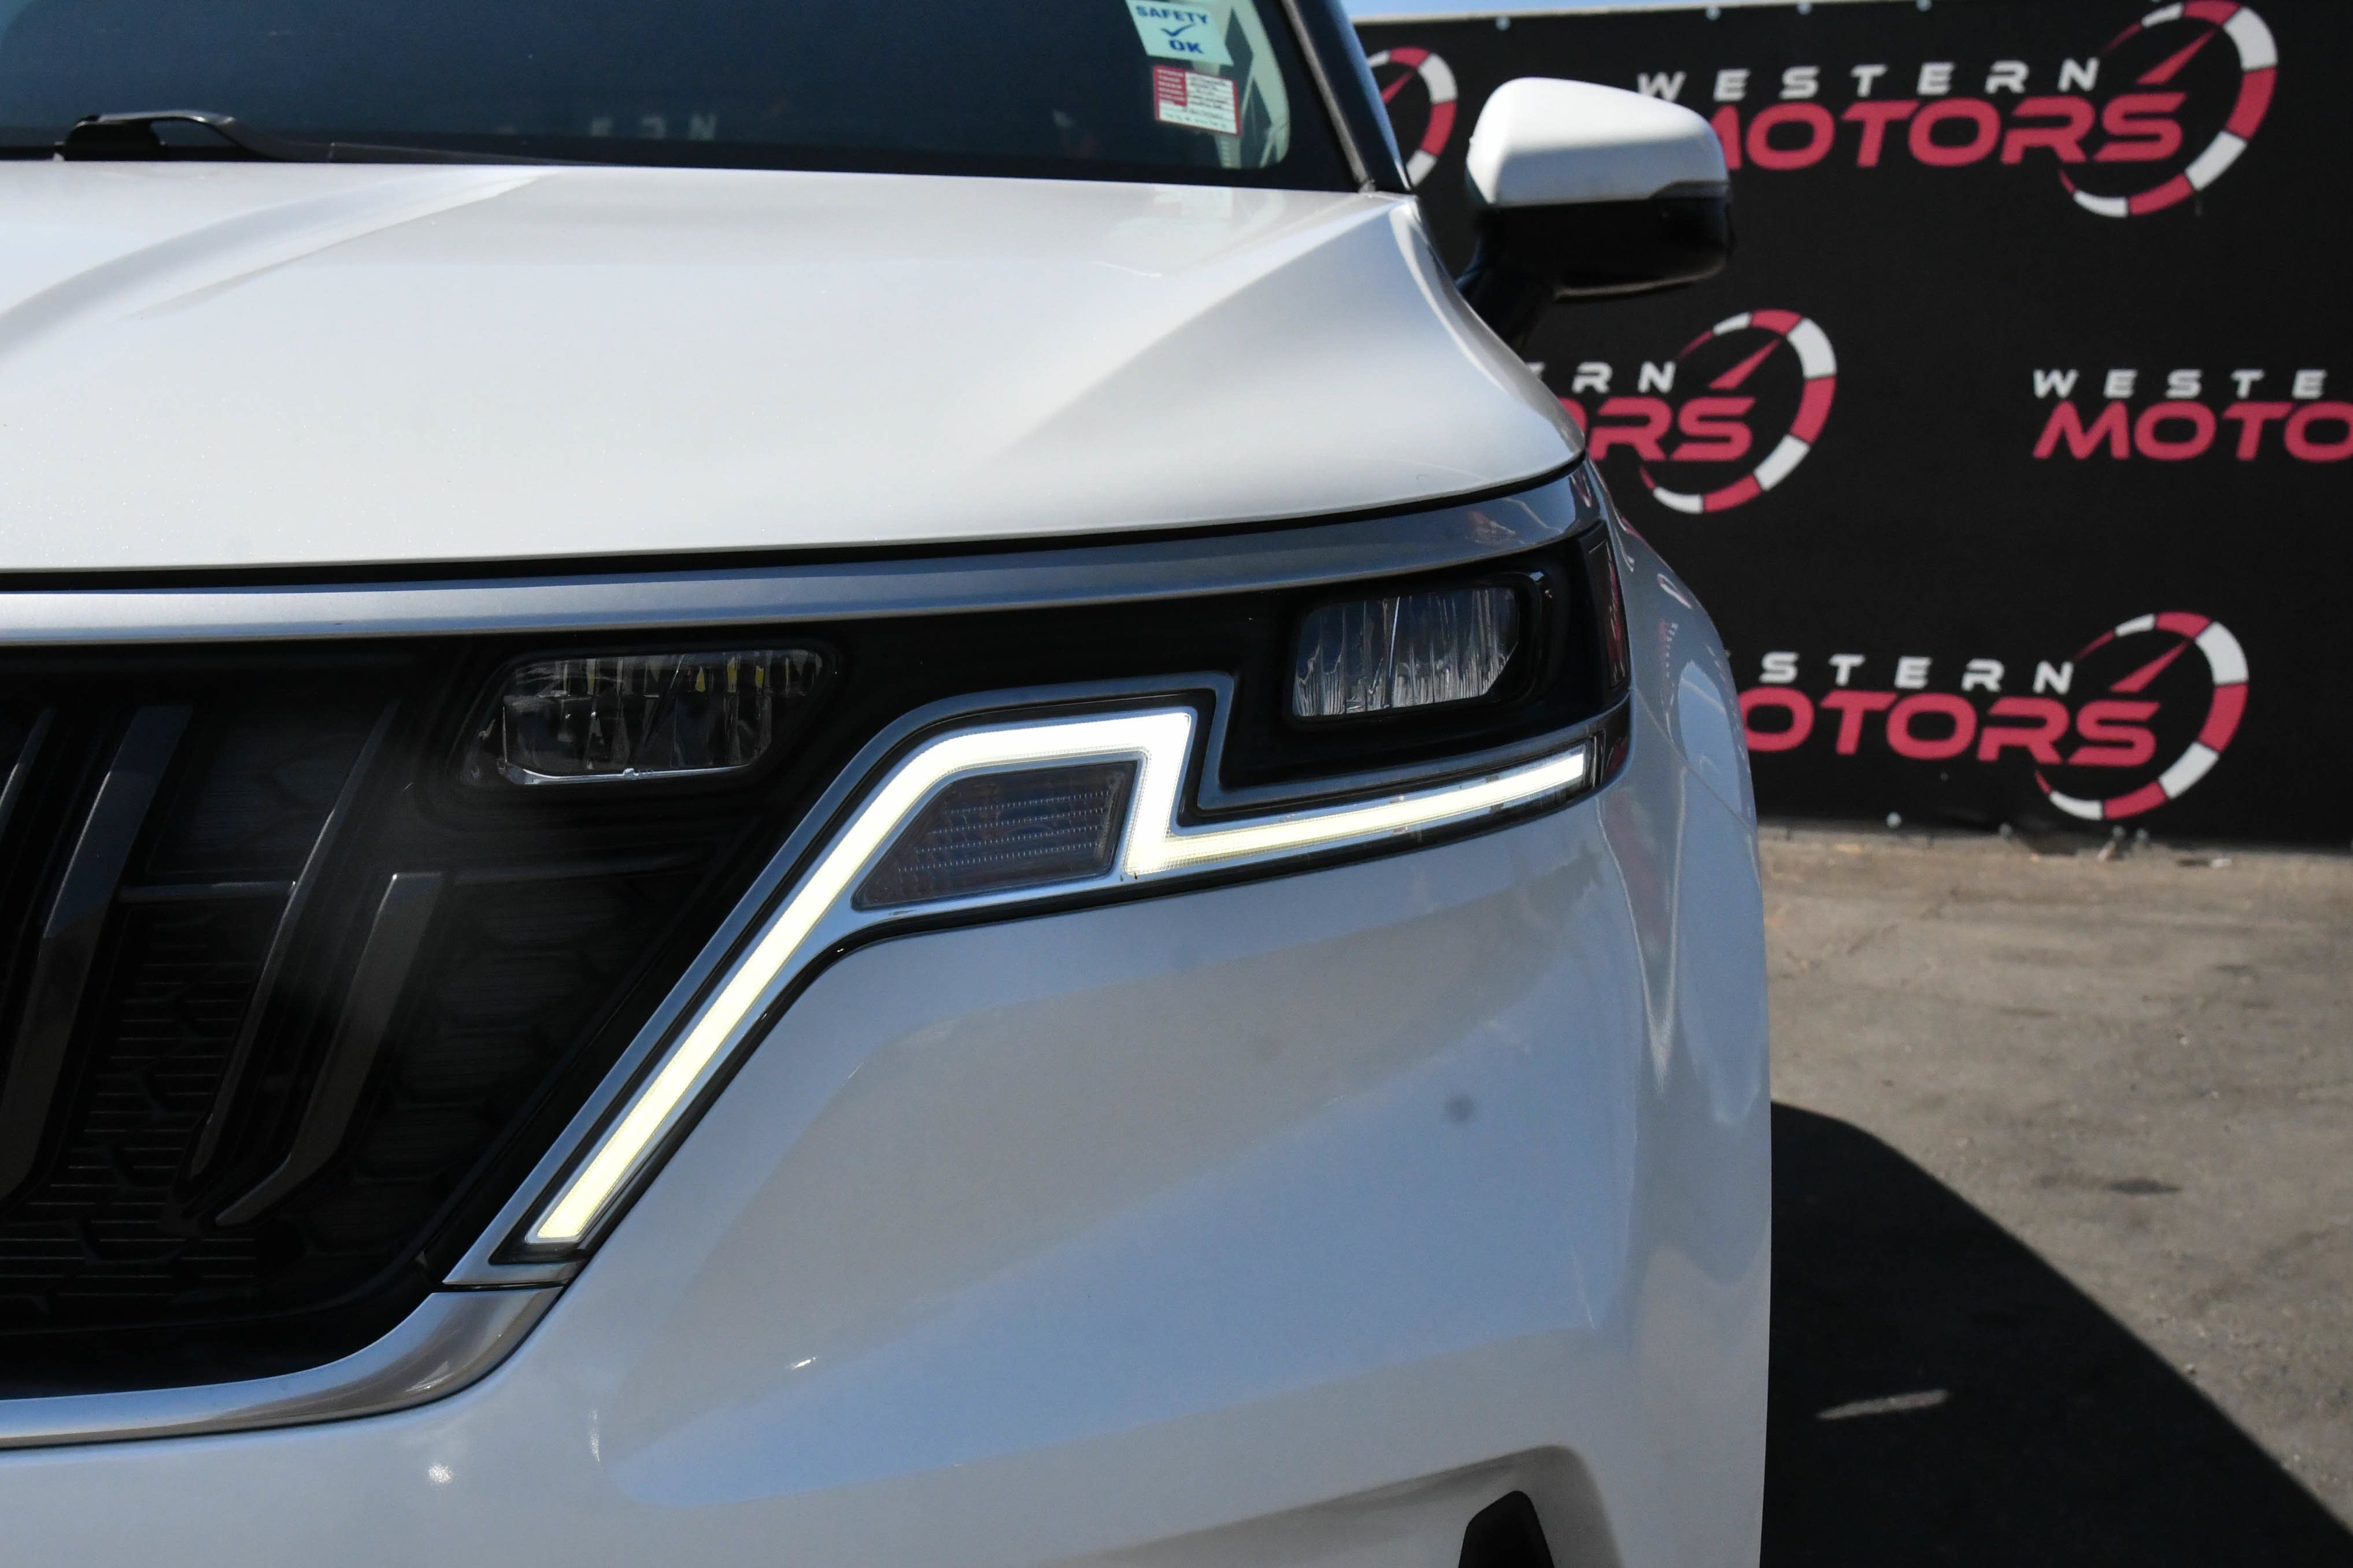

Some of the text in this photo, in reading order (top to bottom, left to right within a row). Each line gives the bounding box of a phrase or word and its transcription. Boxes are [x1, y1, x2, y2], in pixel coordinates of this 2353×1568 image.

[1136, 5, 1208, 24] SAFETY
[1169, 40, 1204, 54] OK
[1637, 57, 2100, 104] WESTERN
[2032, 368, 2328, 399] WESTE
[2032, 399, 2353, 462] MOTO
[1758, 651, 2074, 694] STERN
[1738, 686, 2160, 767] OTORS
